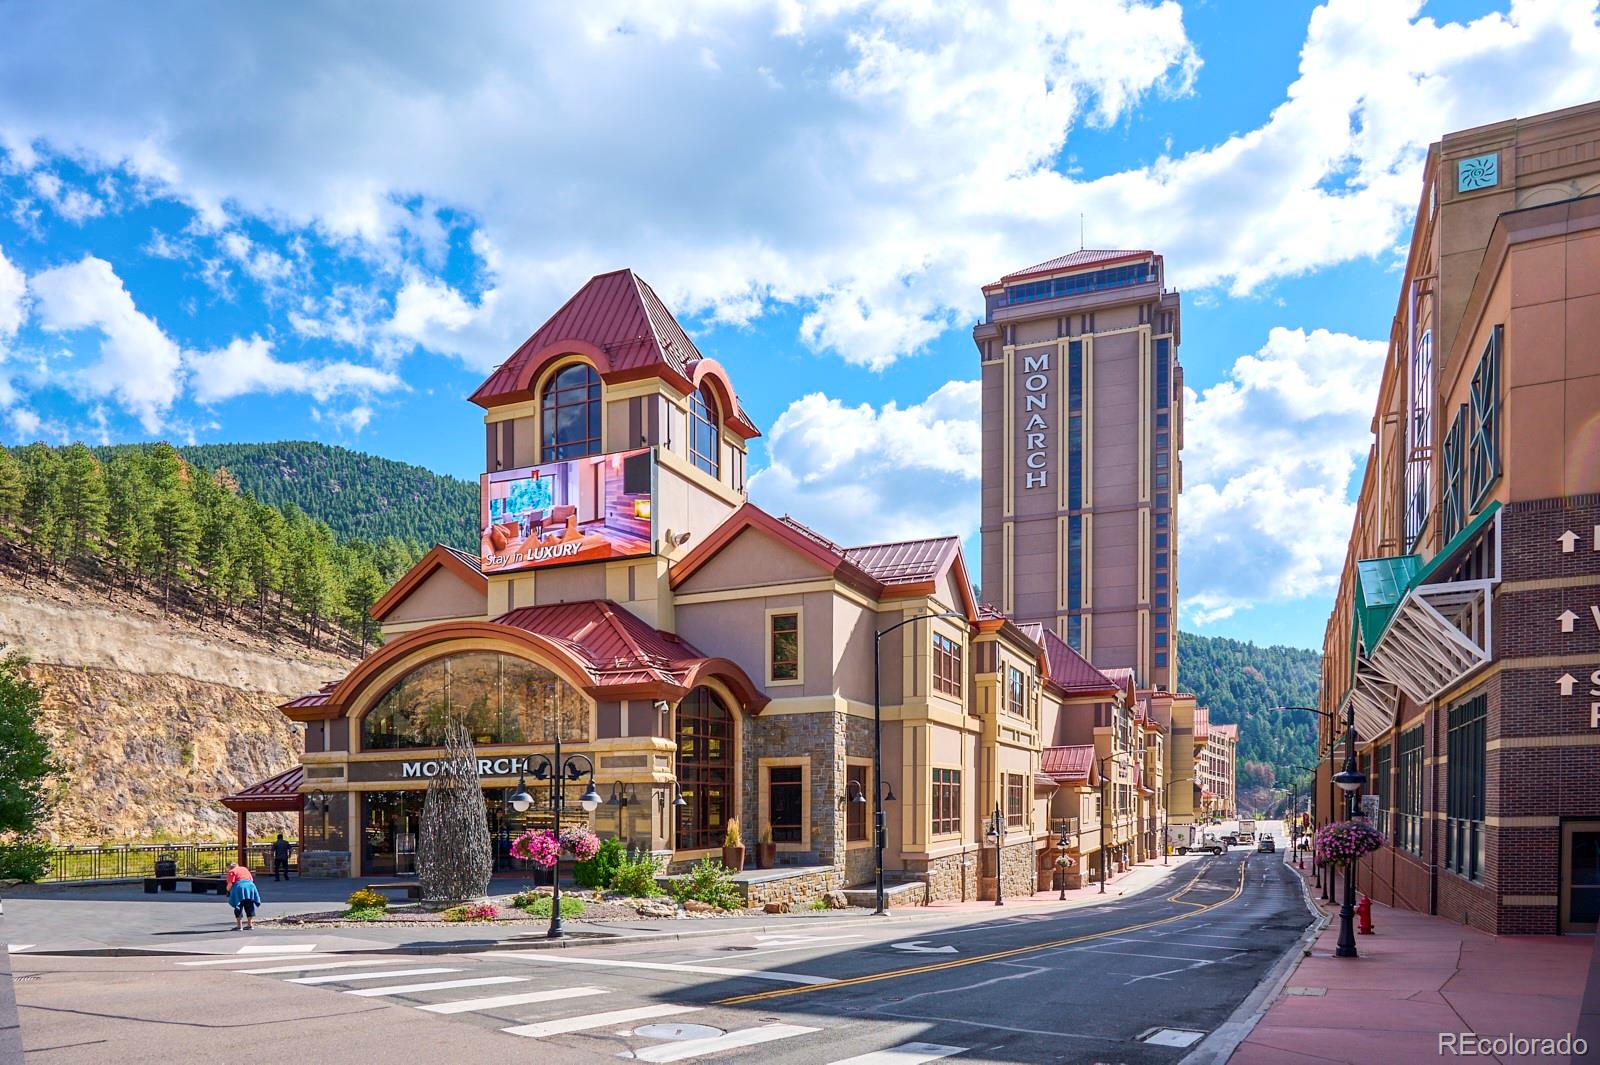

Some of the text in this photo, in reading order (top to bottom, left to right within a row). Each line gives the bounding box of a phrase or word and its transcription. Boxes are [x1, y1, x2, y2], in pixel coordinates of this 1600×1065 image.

[1024, 353, 1050, 489] MONARCH
[486, 542, 582, 567] Stay in LUXURY
